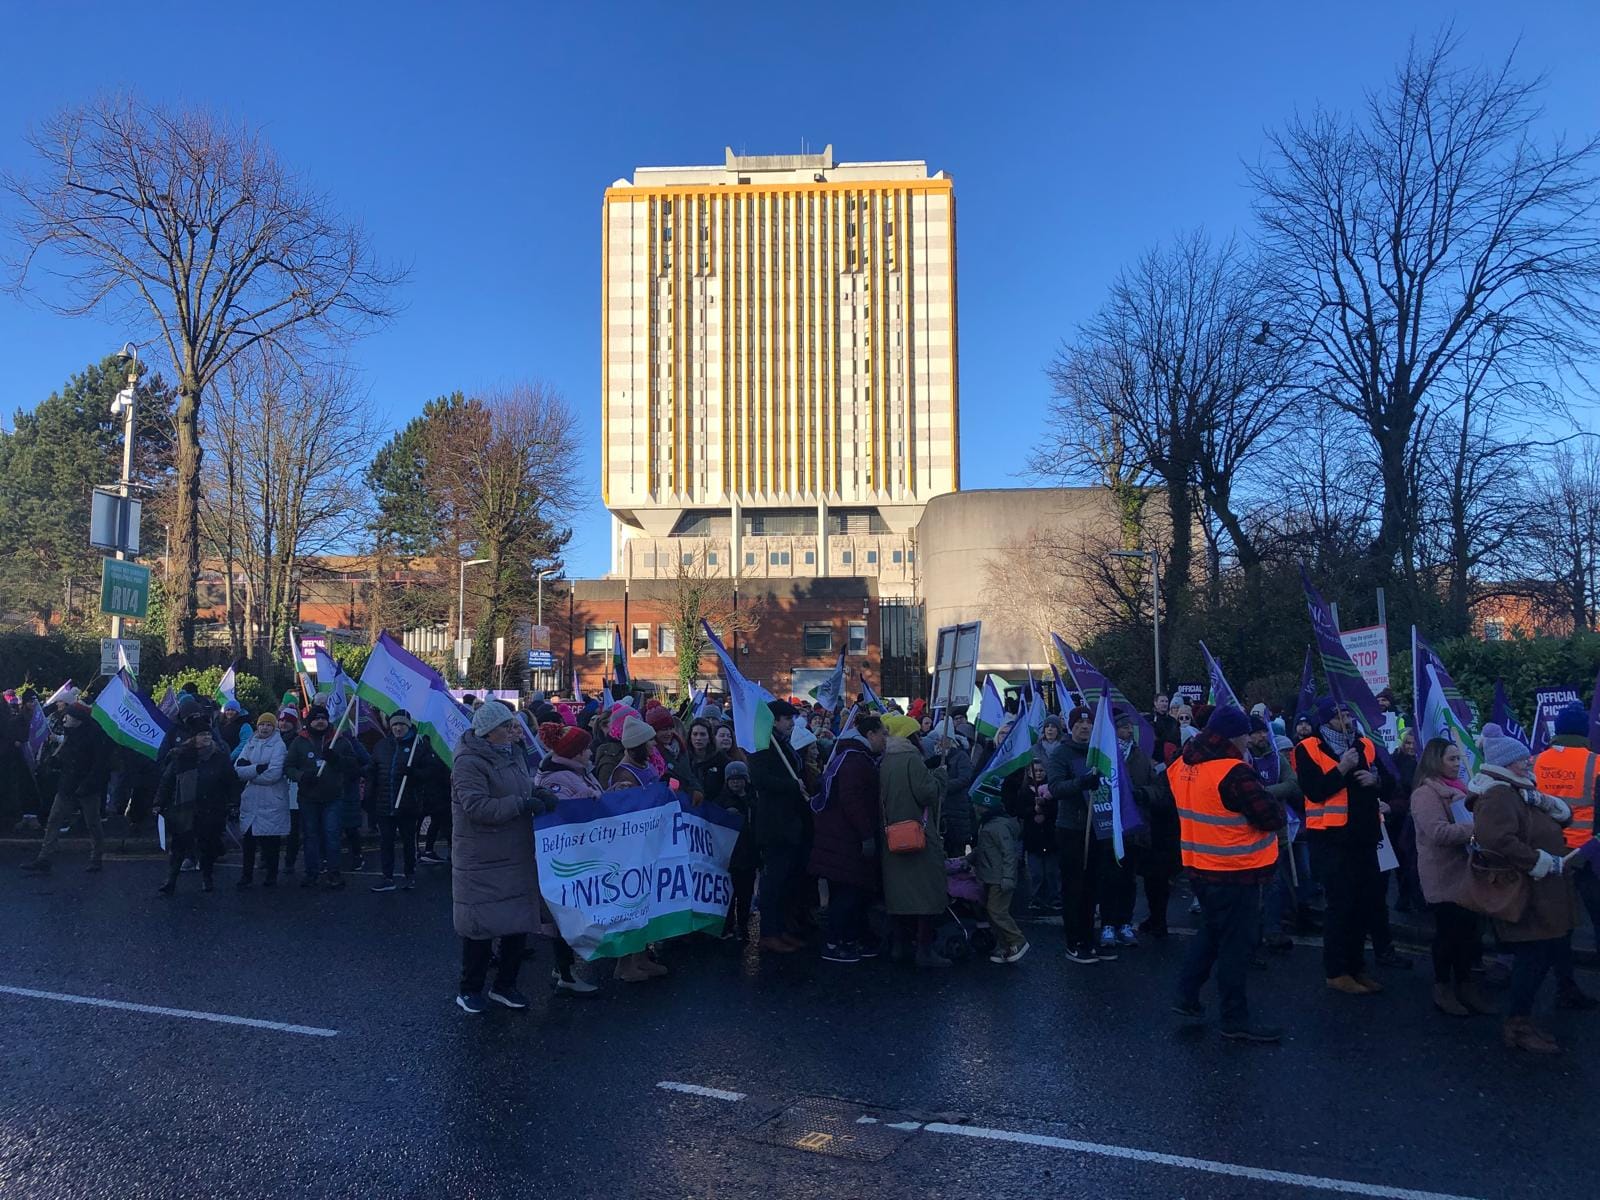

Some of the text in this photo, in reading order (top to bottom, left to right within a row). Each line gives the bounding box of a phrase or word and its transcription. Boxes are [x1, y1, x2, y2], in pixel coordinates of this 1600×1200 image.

[111, 586, 139, 613] RV4
[1352, 651, 1378, 666] STOP
[1536, 690, 1580, 705] OFFICIAL
[118, 703, 160, 738] UNISON
[448, 714, 465, 733] UNIS
[1092, 802, 1113, 813] RIG
[541, 831, 585, 854] Belfast
[588, 822, 617, 846] City
[561, 863, 653, 909] UNISON
